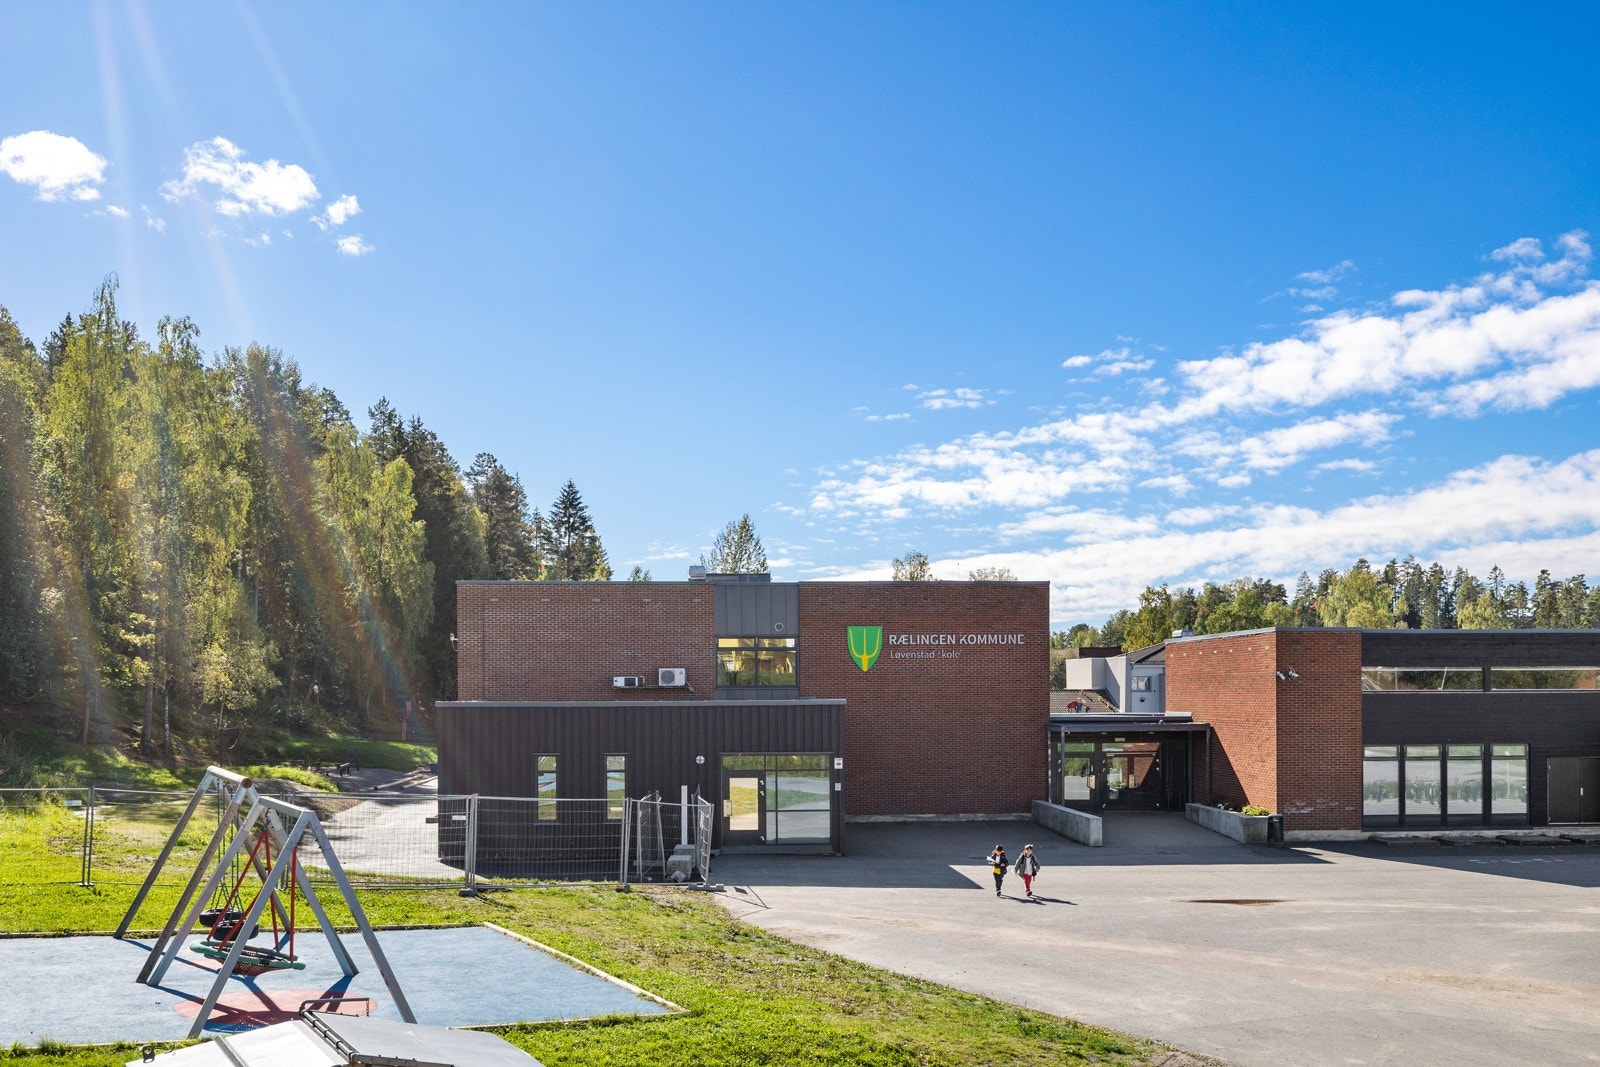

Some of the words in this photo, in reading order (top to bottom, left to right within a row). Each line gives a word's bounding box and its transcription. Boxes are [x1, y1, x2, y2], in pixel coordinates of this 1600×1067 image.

[889, 634, 956, 645] RÆLINGEN
[959, 634, 1025, 645] KOMMUNE
[890, 650, 935, 659] Løvenstad
